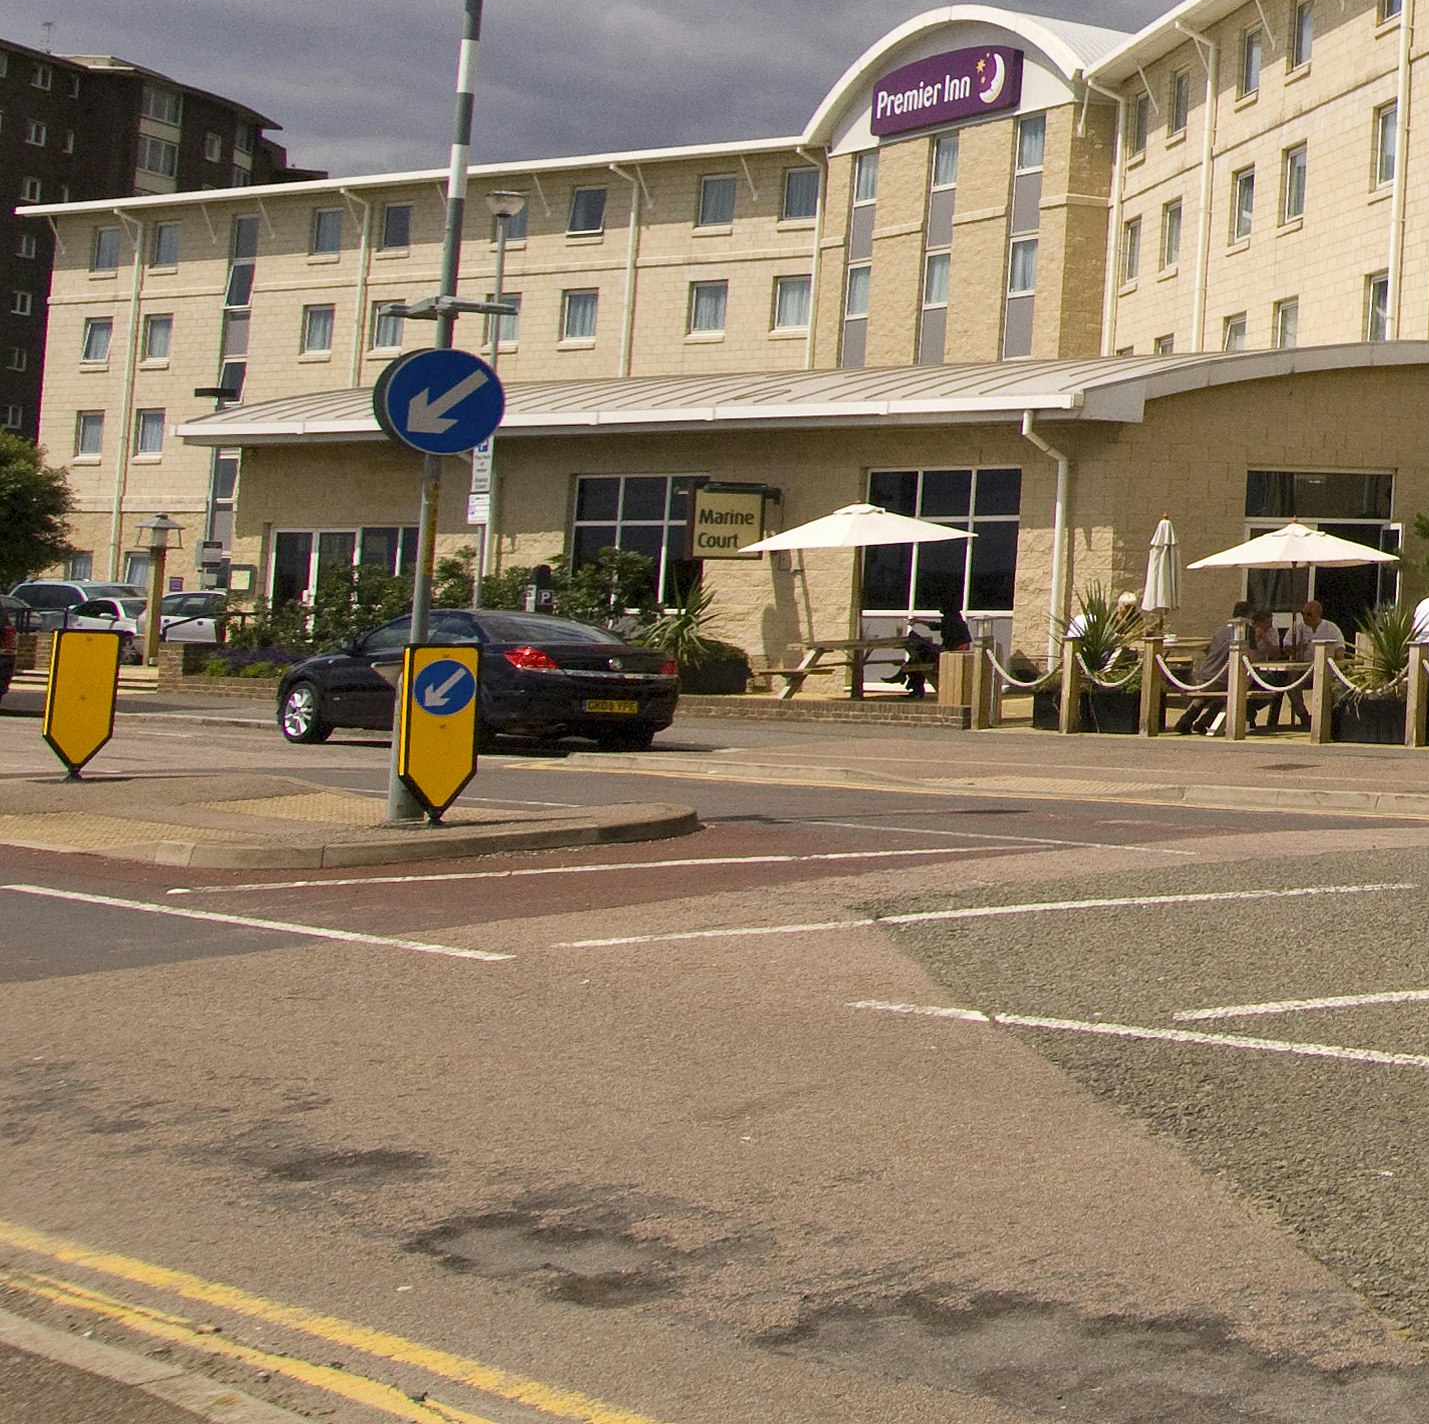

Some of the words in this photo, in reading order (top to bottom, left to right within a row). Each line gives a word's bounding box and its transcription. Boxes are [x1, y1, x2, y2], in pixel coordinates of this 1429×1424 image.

[876, 81, 942, 119] Premier
[944, 74, 971, 103] Inn
[698, 508, 755, 525] Marine
[697, 532, 739, 549] Court
